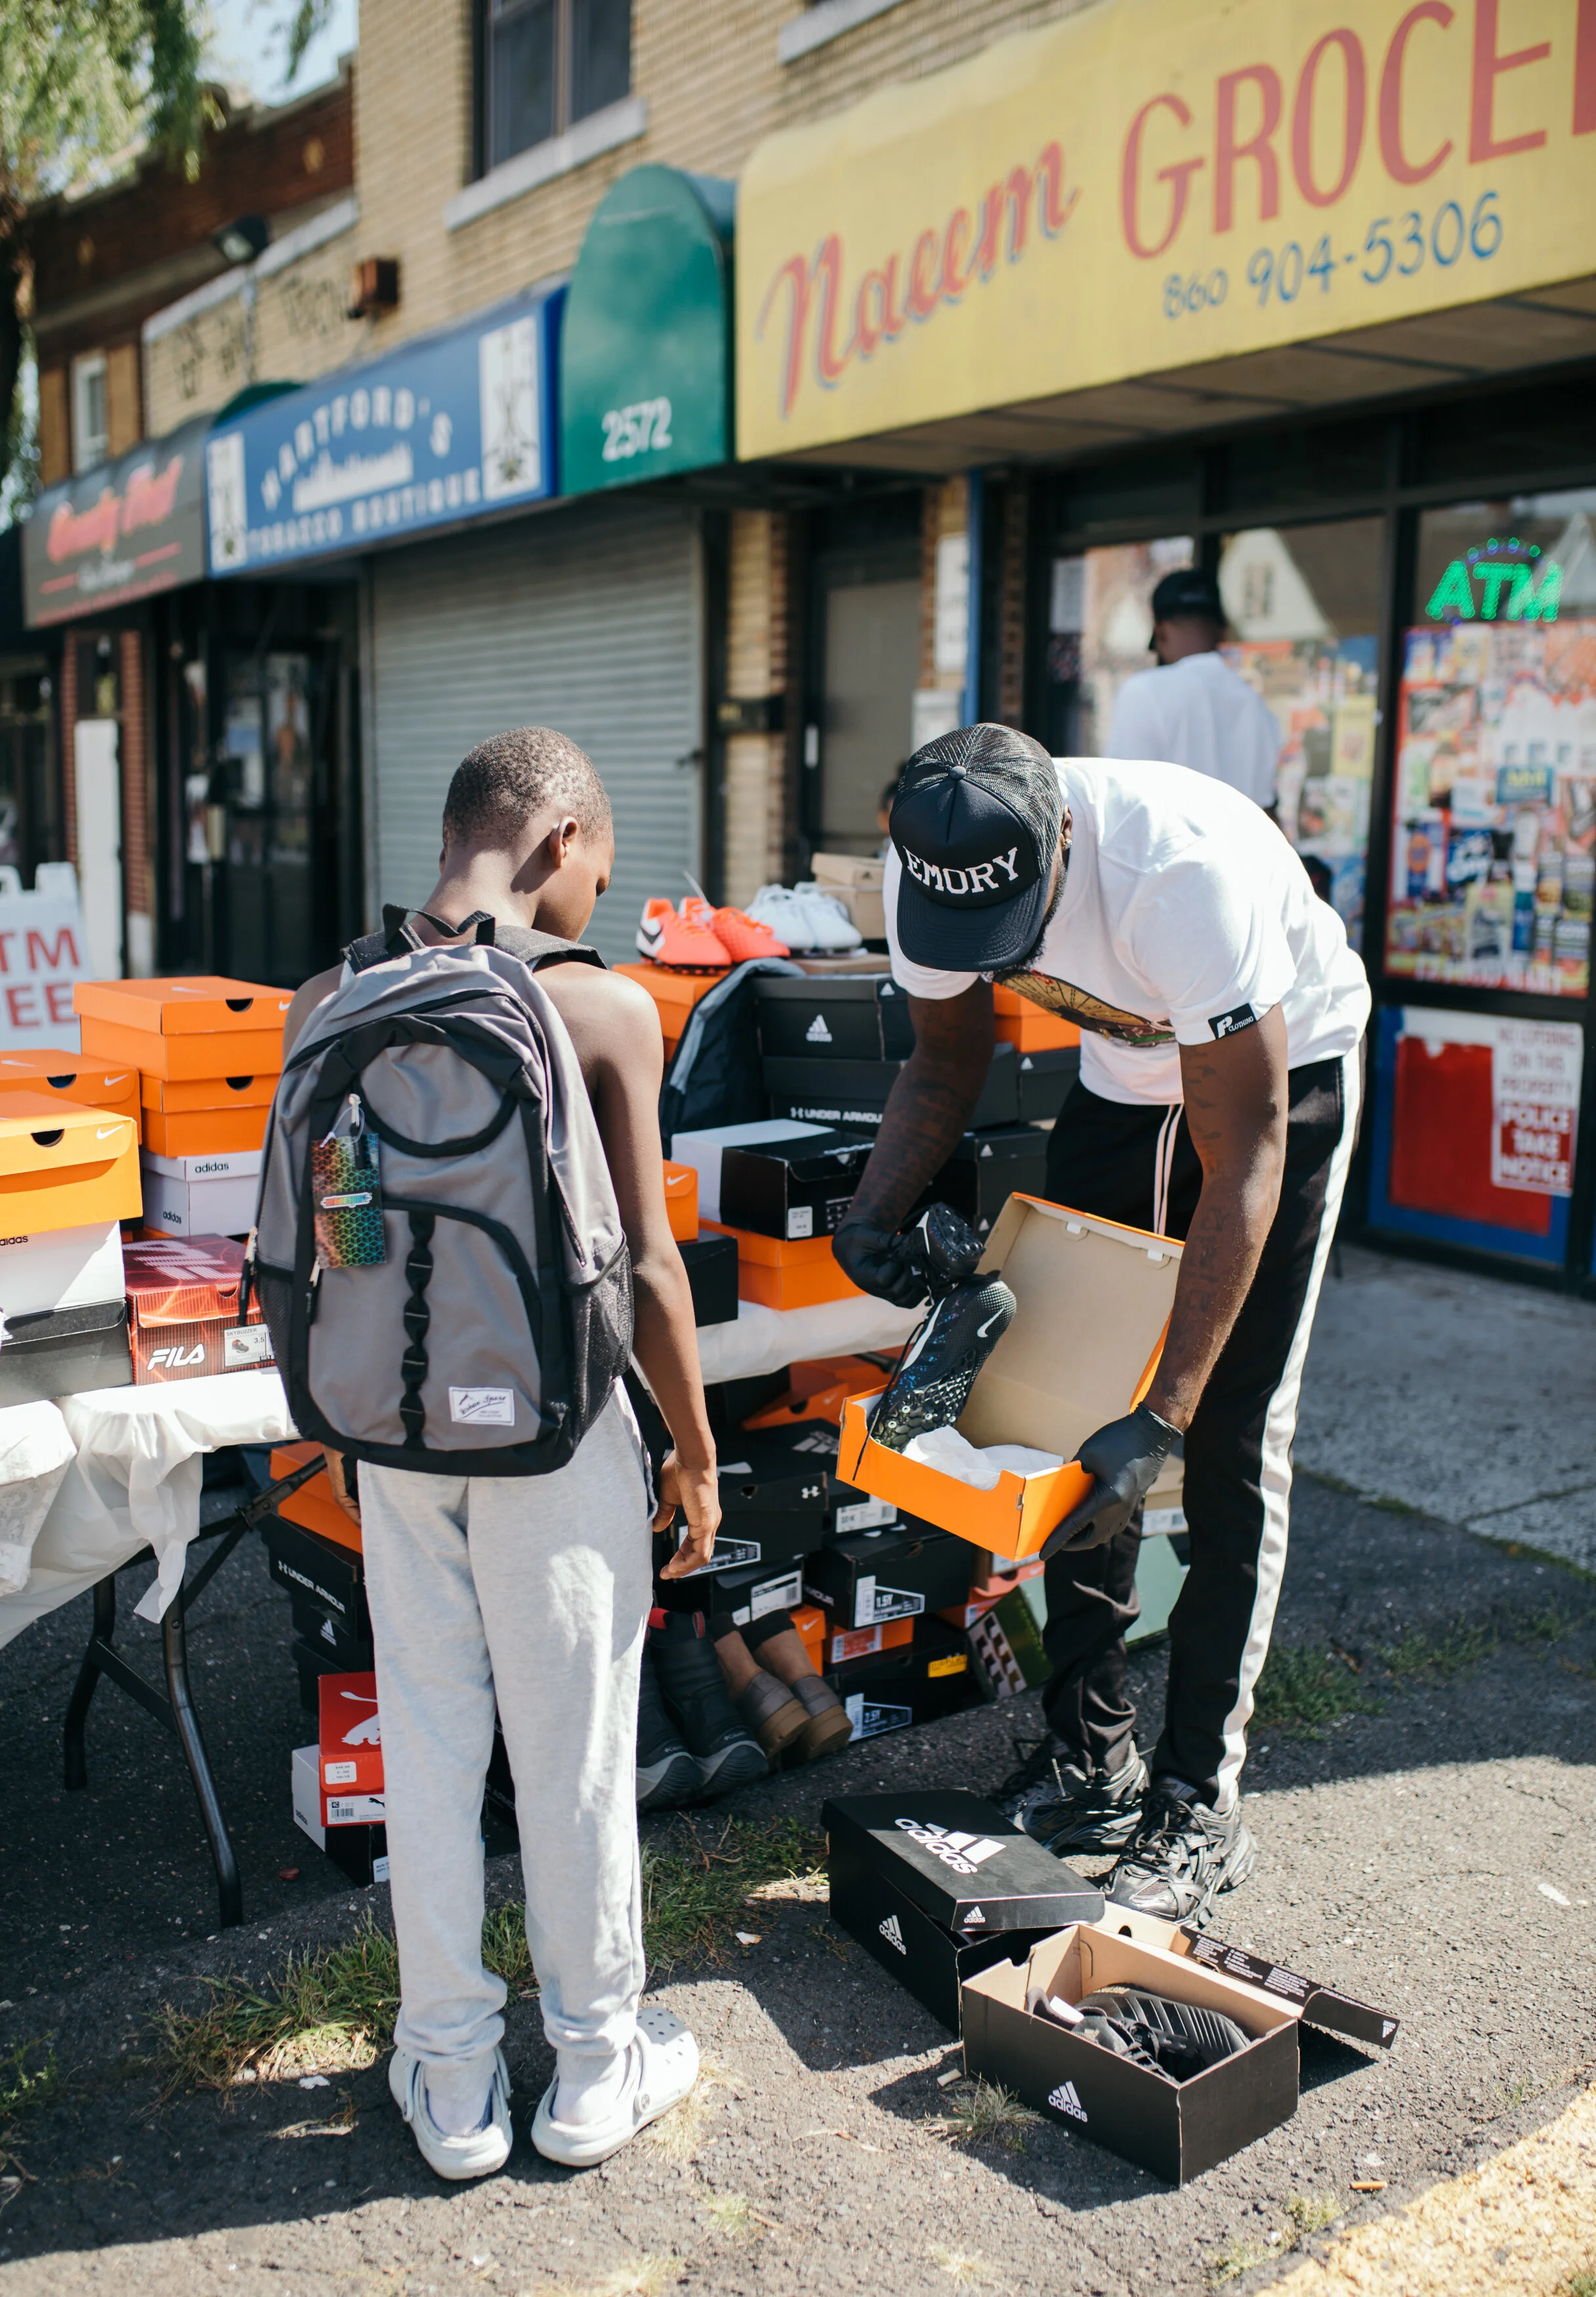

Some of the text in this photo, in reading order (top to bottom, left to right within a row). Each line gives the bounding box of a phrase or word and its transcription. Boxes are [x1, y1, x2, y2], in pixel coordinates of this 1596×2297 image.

[1163, 190, 1503, 320] 860 904-5306
[601, 396, 673, 462] 2572
[1425, 560, 1565, 622] ATM
[902, 845, 1019, 895] EMORY
[1228, 1016, 1254, 1032] CLOTHING
[805, 1108, 841, 1120] UNDER
[1502, 1105, 1571, 1133] POLICE
[1512, 1130, 1561, 1158] TAKE
[194, 1162, 229, 1173] adidas
[1502, 1155, 1570, 1186] NOTICE
[163, 1210, 182, 1225] adidas
[226, 1328, 257, 1337] SKYBUZZER
[147, 1343, 205, 1371] FILA
[288, 1567, 346, 1614] UNDER ARMOUR
[894, 1818, 978, 1874] adidas
[879, 1924, 907, 1955] adidas
[1048, 2093, 1088, 2123] adidas
